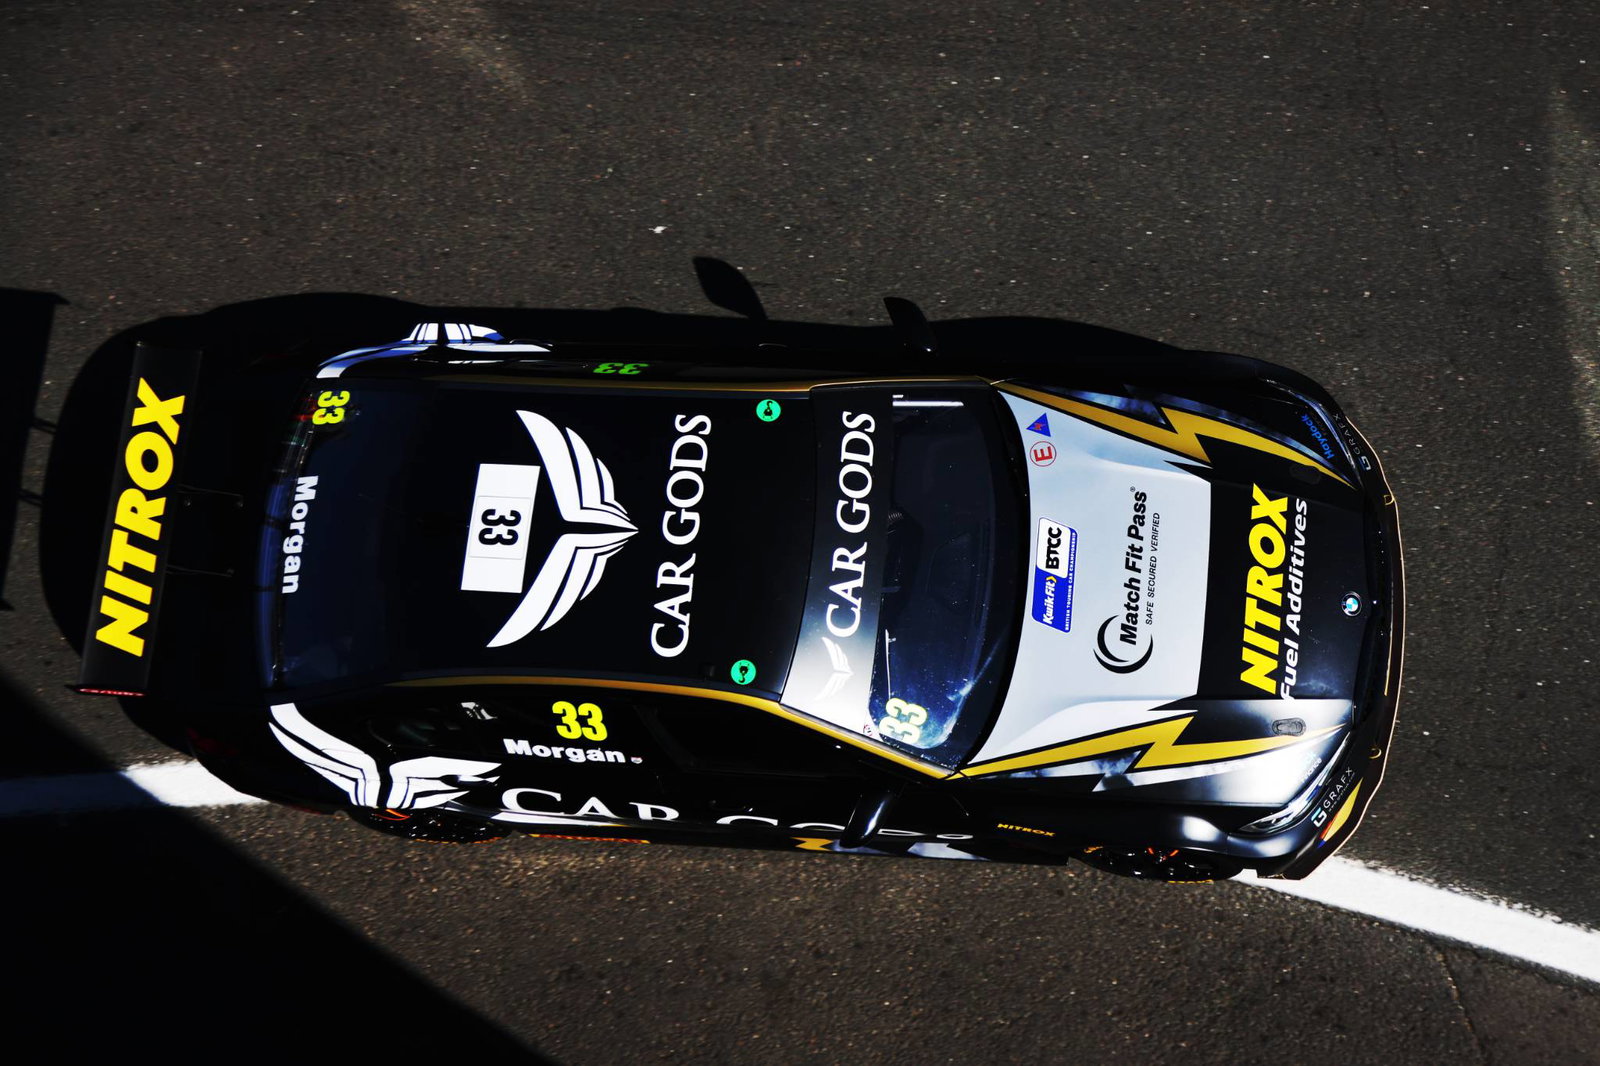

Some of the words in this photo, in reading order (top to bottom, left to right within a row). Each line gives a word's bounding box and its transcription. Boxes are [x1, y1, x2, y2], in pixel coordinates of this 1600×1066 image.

[311, 390, 351, 425] 33
[1033, 446, 1053, 462] E
[1300, 413, 1335, 459] Haydock
[1333, 413, 1361, 455] GRAFX
[662, 414, 712, 545] GODS
[836, 410, 876, 533] GODS
[95, 377, 186, 657] NITROX
[282, 475, 319, 594] Morgan
[478, 508, 522, 546] 33
[1127, 491, 1148, 541] Pass
[1150, 512, 1160, 552] VERIFIED
[1045, 526, 1063, 570] BTCC
[1068, 532, 1077, 571] CHAMPIONSHIP
[1125, 543, 1144, 574] Fit
[1285, 498, 1307, 635] Additives
[826, 542, 868, 637] CAR
[1147, 555, 1157, 598] SECURED
[1240, 483, 1288, 694] NITROX
[651, 553, 696, 658] CAR
[1119, 577, 1141, 645] Match
[1145, 601, 1154, 625] SAFE
[1280, 637, 1300, 700] Fuel
[552, 700, 608, 742] 33
[879, 697, 928, 745] 33
[503, 738, 626, 764] Morgan
[1323, 766, 1353, 809] GRAFX
[997, 822, 1056, 837] NITROX
